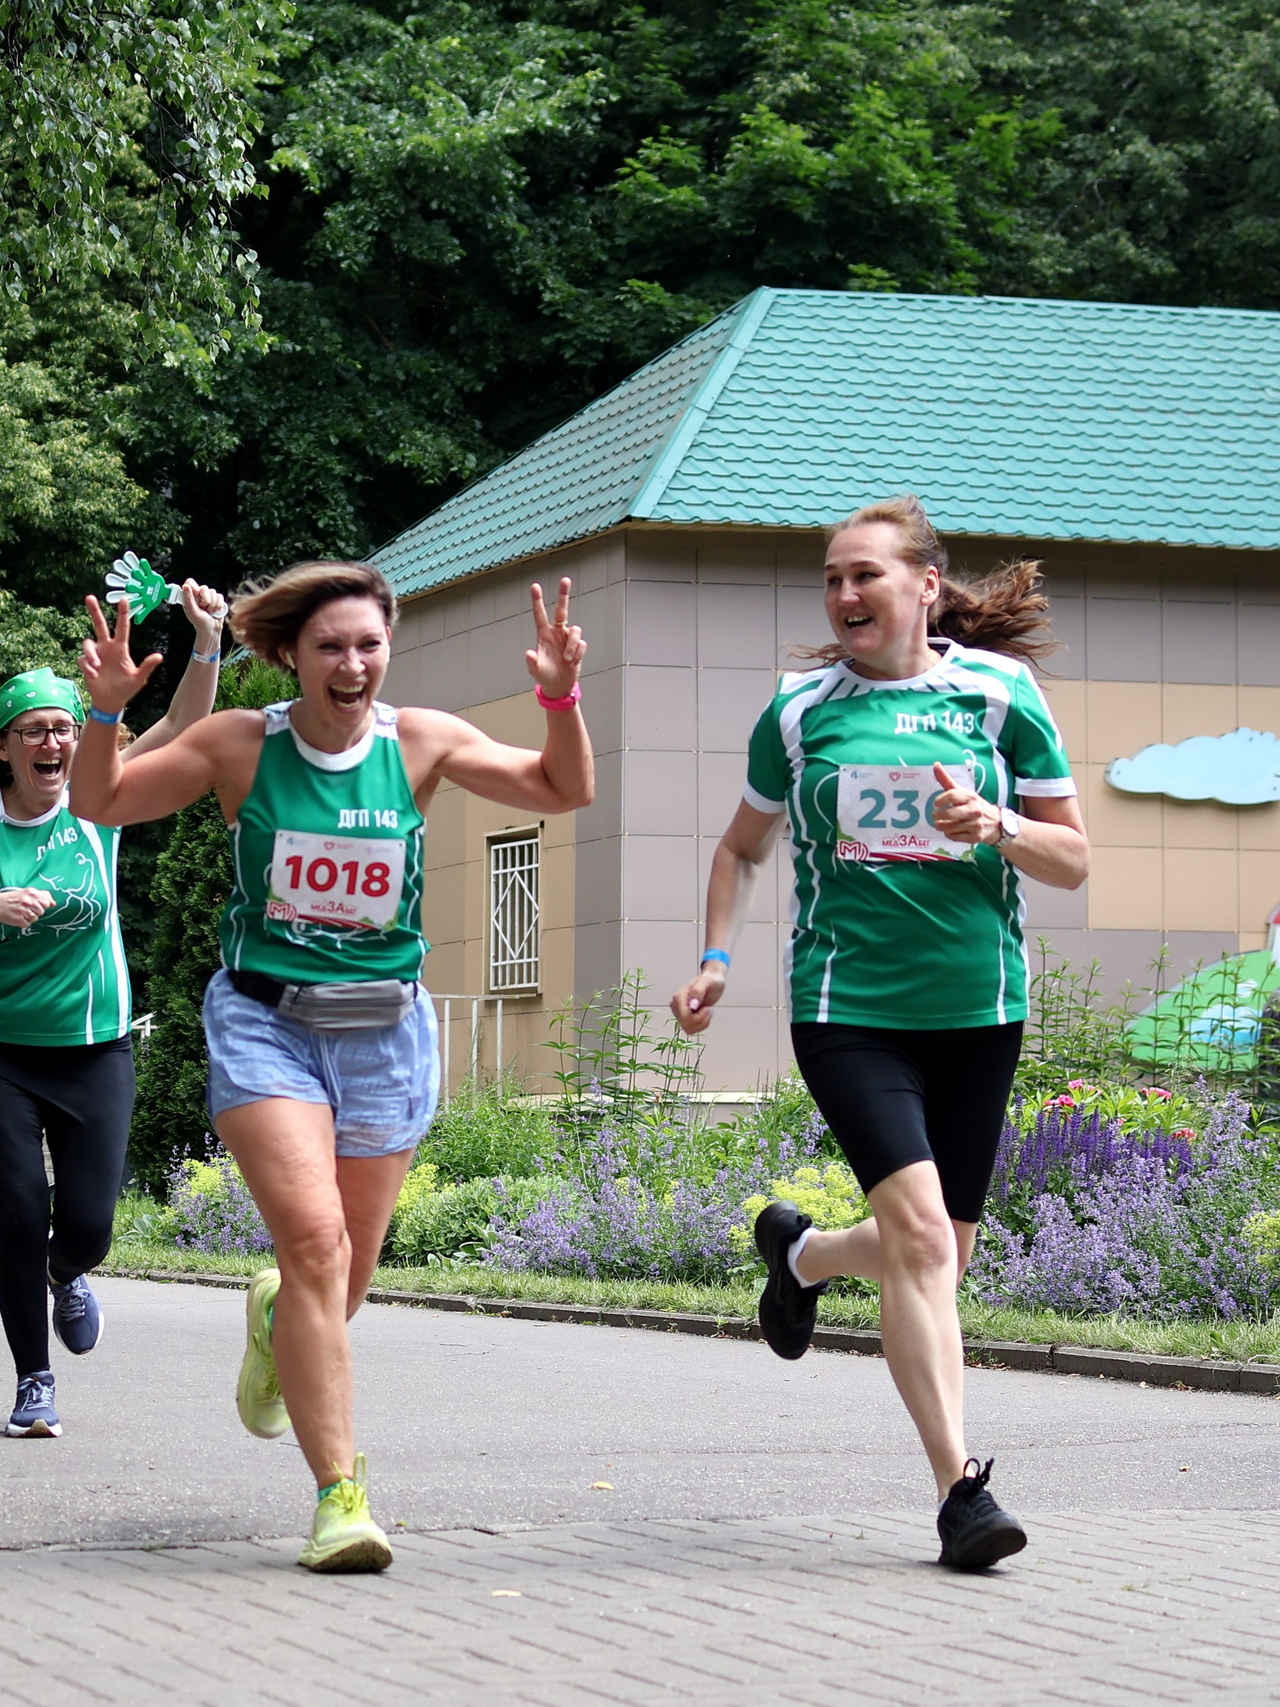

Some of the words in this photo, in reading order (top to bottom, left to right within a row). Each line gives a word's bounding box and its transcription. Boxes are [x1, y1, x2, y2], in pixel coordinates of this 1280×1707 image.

[894, 712, 937, 735] ДГП
[941, 710, 975, 734] 143
[337, 809, 370, 829] ДГП
[373, 809, 398, 829] 143
[36, 835, 55, 862] ДП
[55, 826, 79, 847] 143
[285, 855, 390, 898] 1018
